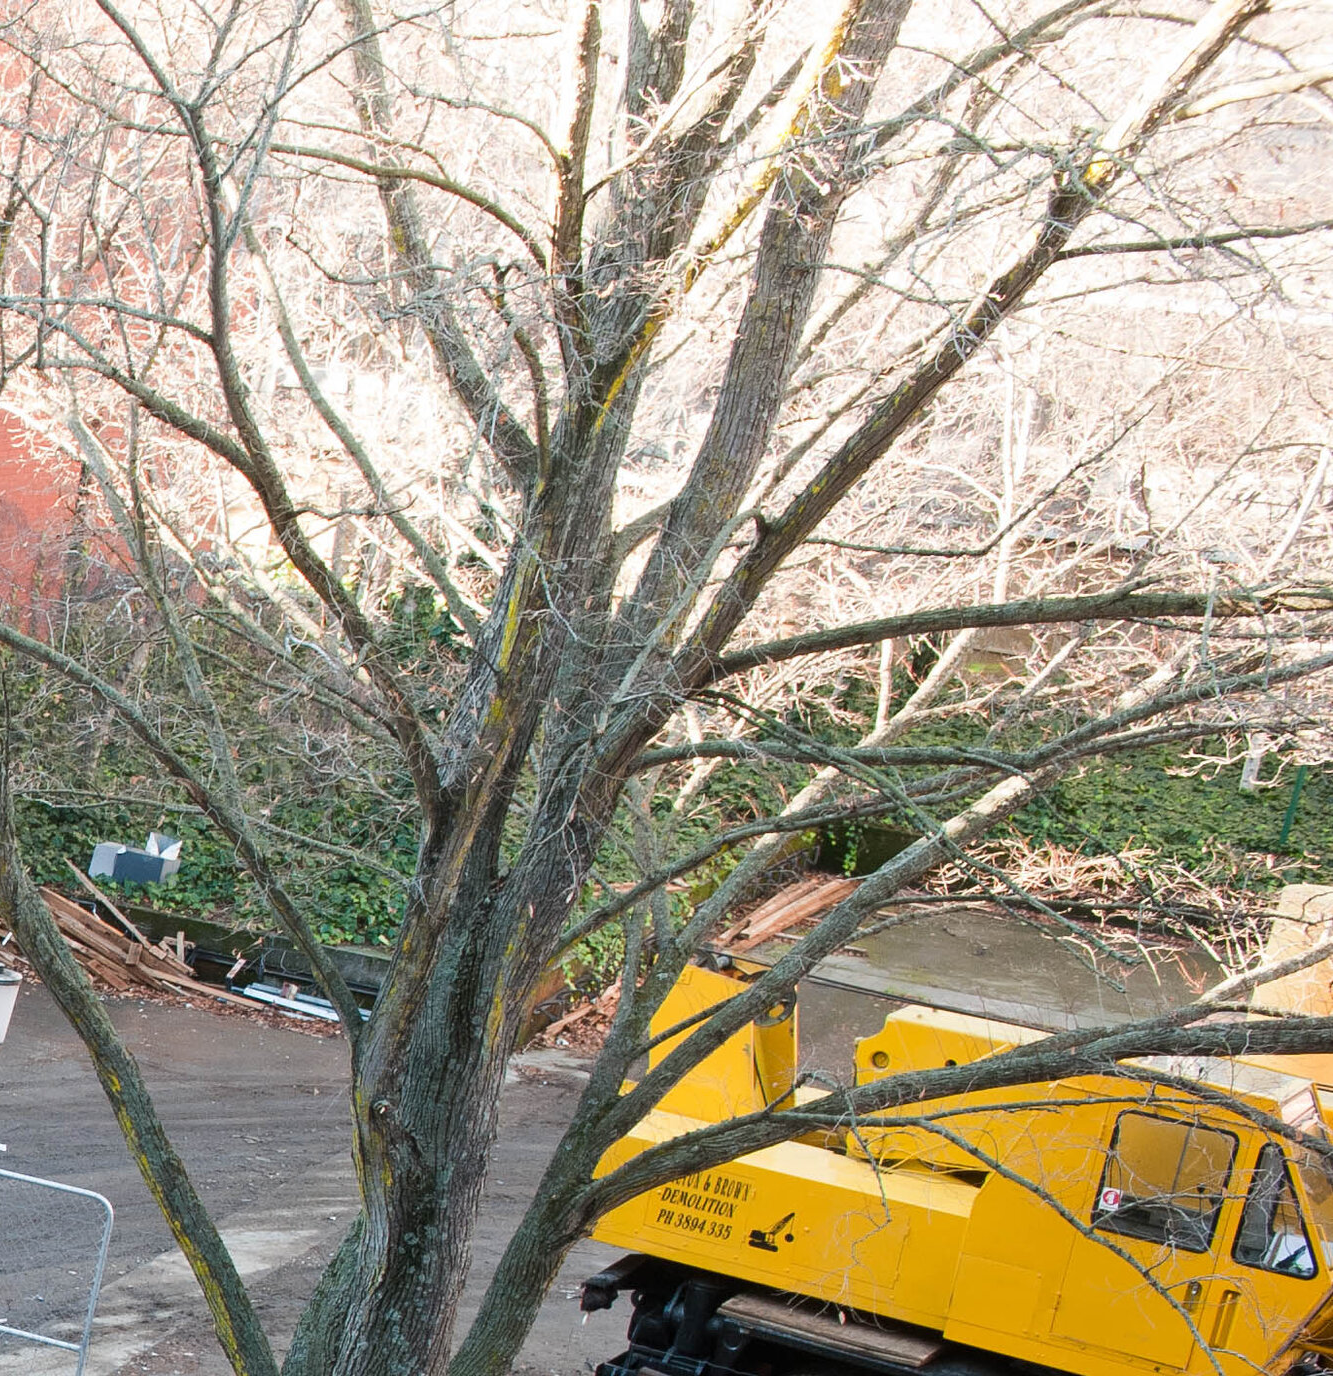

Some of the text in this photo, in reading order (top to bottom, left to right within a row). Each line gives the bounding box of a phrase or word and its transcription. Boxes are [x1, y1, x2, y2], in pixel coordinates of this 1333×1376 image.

[660, 1187, 738, 1219] DEMOLITION
[713, 1175, 751, 1201] BROWN
[656, 1208, 733, 1240] PH 3894 335
